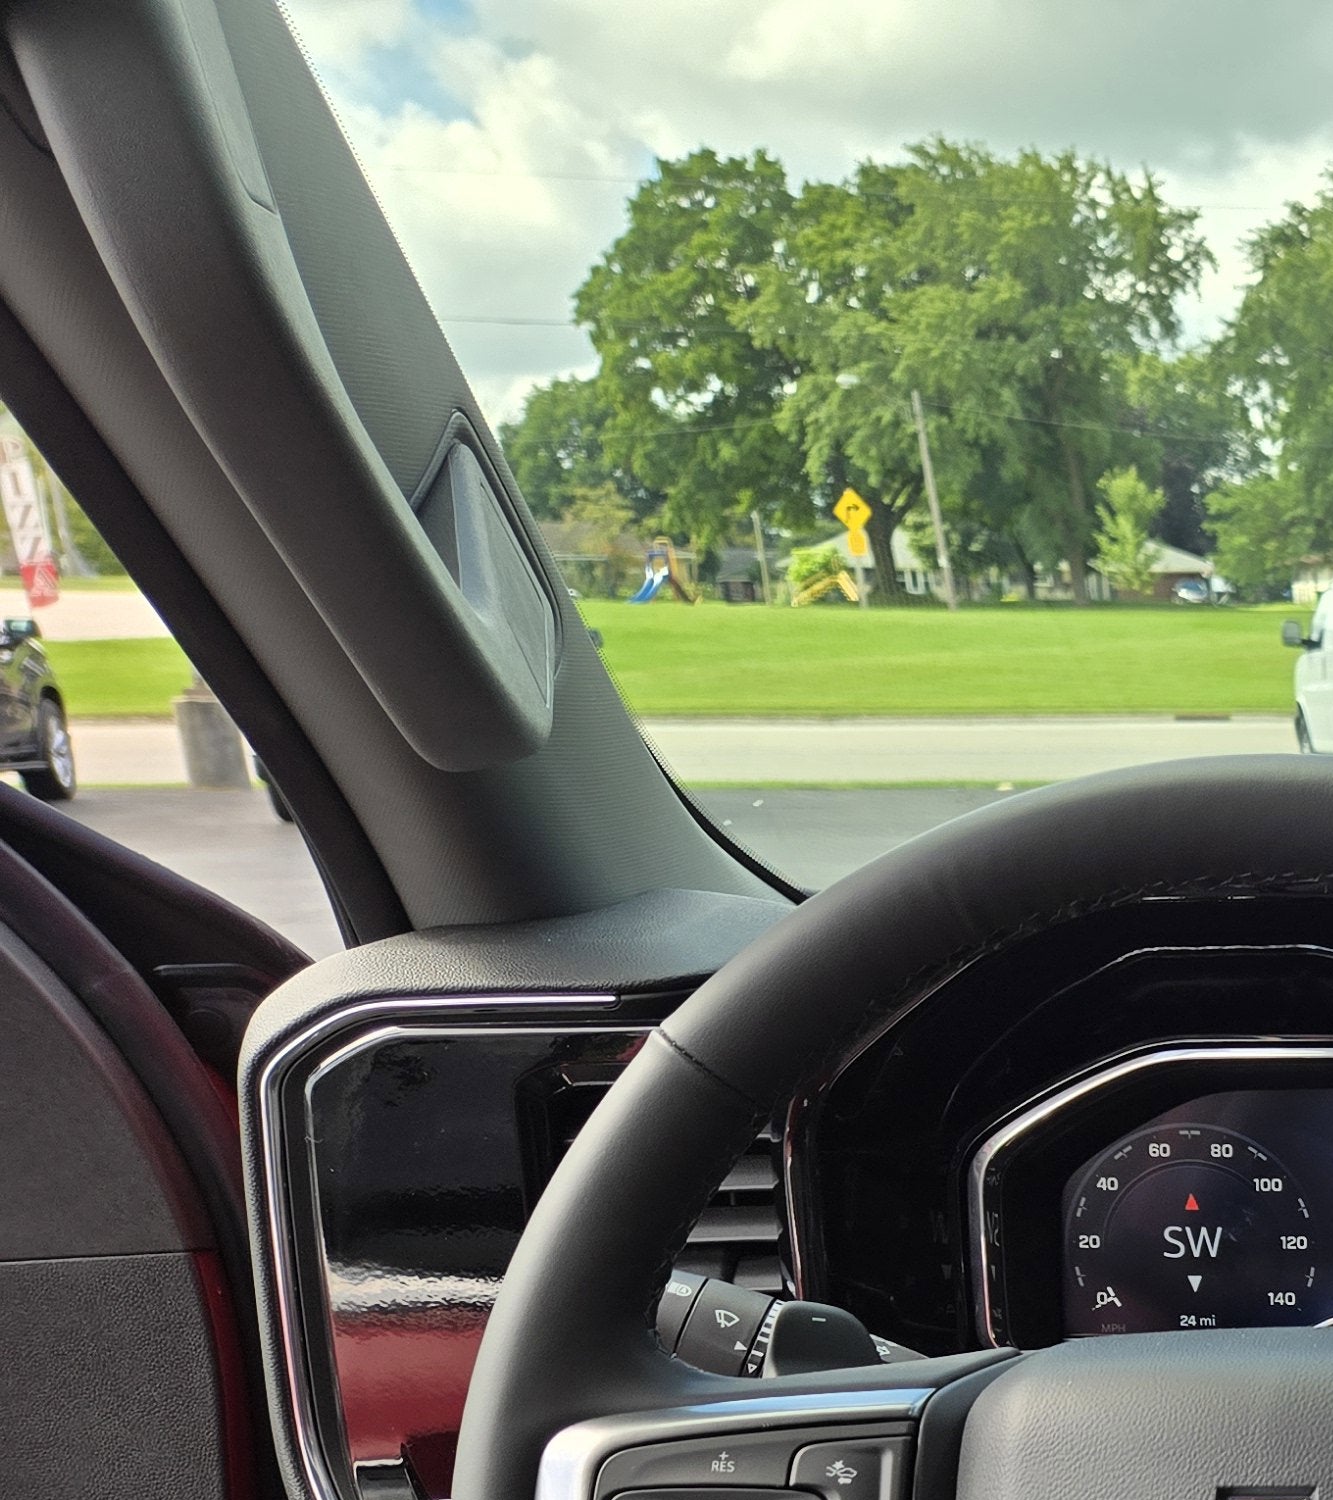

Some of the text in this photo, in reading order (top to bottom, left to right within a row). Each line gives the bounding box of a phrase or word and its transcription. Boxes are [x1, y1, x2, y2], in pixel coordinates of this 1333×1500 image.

[1149, 1143, 1170, 1157] 60
[1211, 1144, 1233, 1157] 80
[1097, 1177, 1118, 1190] 40
[1254, 1178, 1282, 1191] 100
[1079, 1235, 1100, 1248] 20
[1164, 1226, 1222, 1258] SW
[1280, 1236, 1307, 1249] 120
[1268, 1292, 1295, 1305] 140
[1180, 1315, 1216, 1326] 24 mi
[1101, 1323, 1126, 1333] MPH
[711, 1461, 734, 1473] RES
